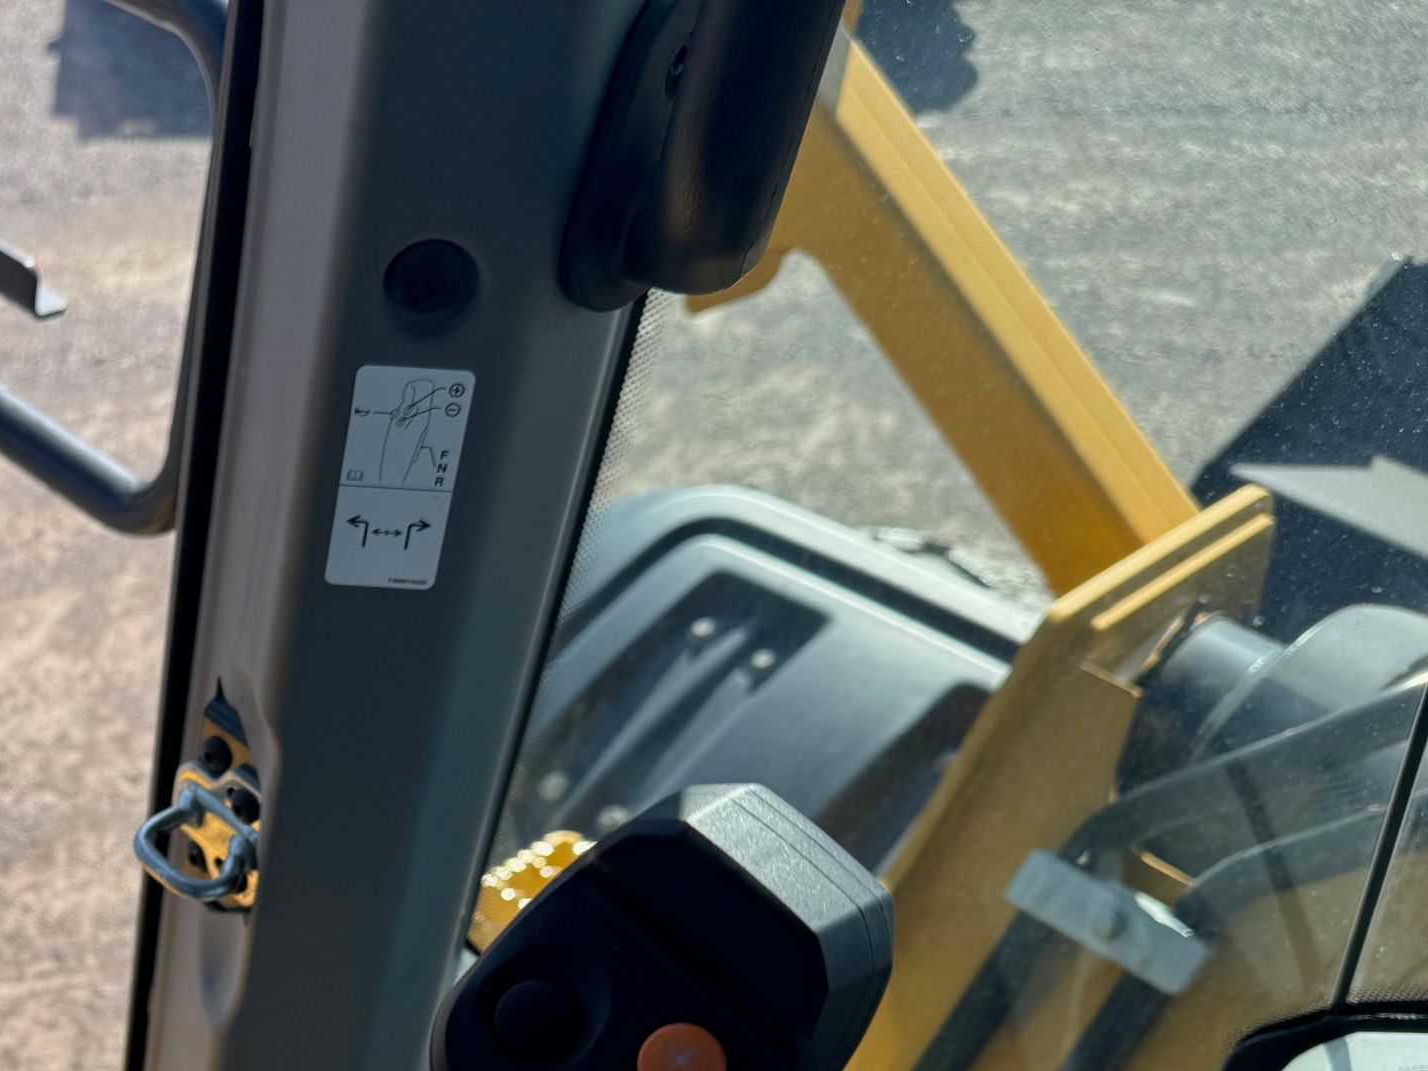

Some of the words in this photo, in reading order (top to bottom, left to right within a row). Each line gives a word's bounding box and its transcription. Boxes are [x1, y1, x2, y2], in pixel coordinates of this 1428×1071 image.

[439, 450, 450, 460] F
[436, 463, 447, 474] N
[434, 476, 444, 487] R
